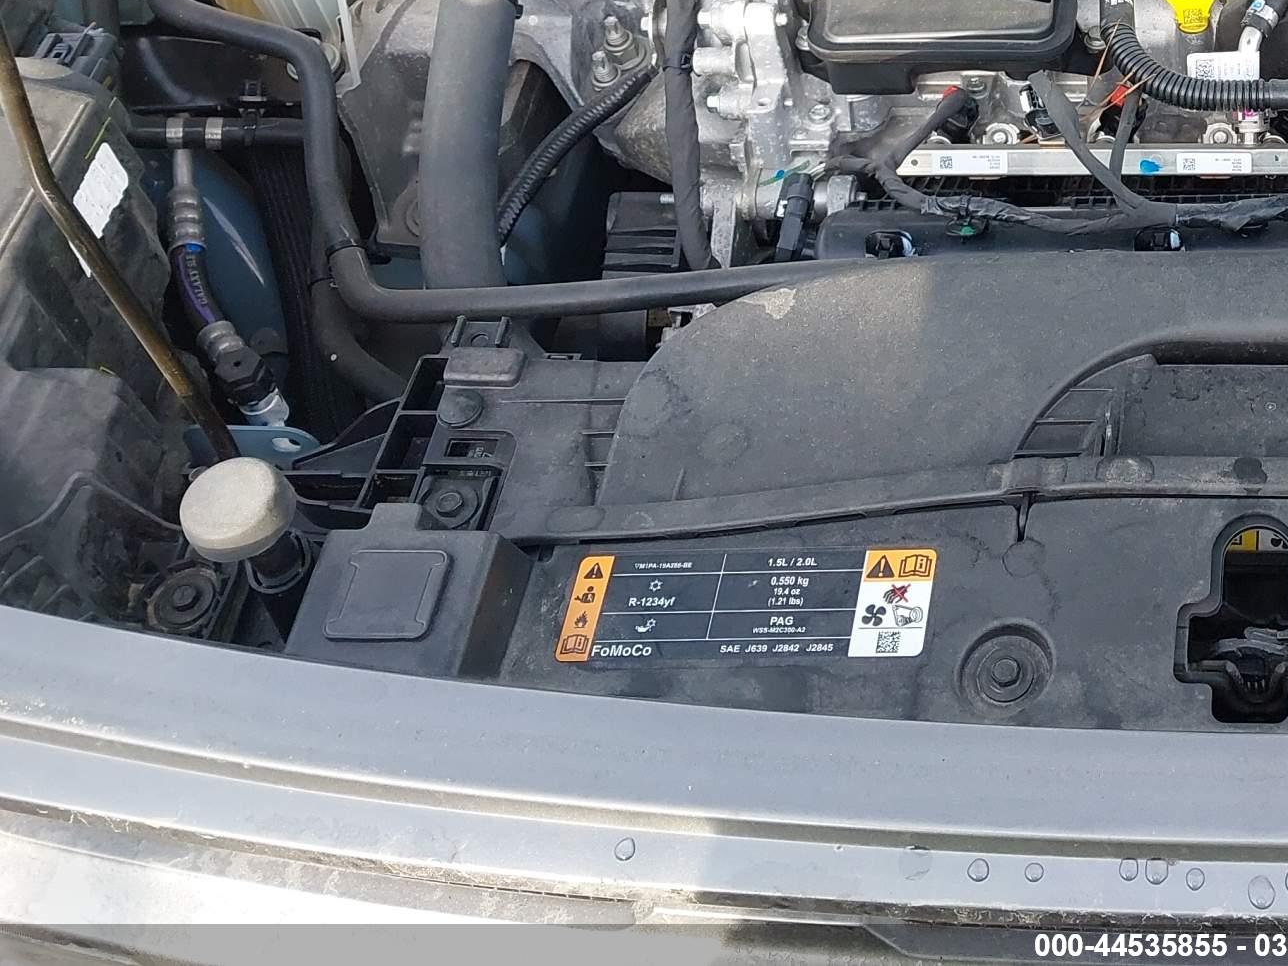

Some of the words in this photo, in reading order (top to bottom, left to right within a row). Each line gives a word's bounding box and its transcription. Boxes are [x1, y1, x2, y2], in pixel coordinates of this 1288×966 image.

[768, 558, 787, 567] 1.5L
[796, 557, 818, 567] 2.0L
[770, 576, 791, 586] 0.550
[794, 576, 809, 587] kg
[773, 588, 788, 596] 19.4
[629, 596, 675, 609] R-1234yf
[768, 597, 787, 606] (1.21
[770, 616, 794, 626] PAG
[591, 644, 652, 657] FoMoCo
[720, 644, 741, 653] SAE
[745, 644, 768, 653] J639
[773, 643, 799, 653] J2842
[806, 643, 834, 652] J2845
